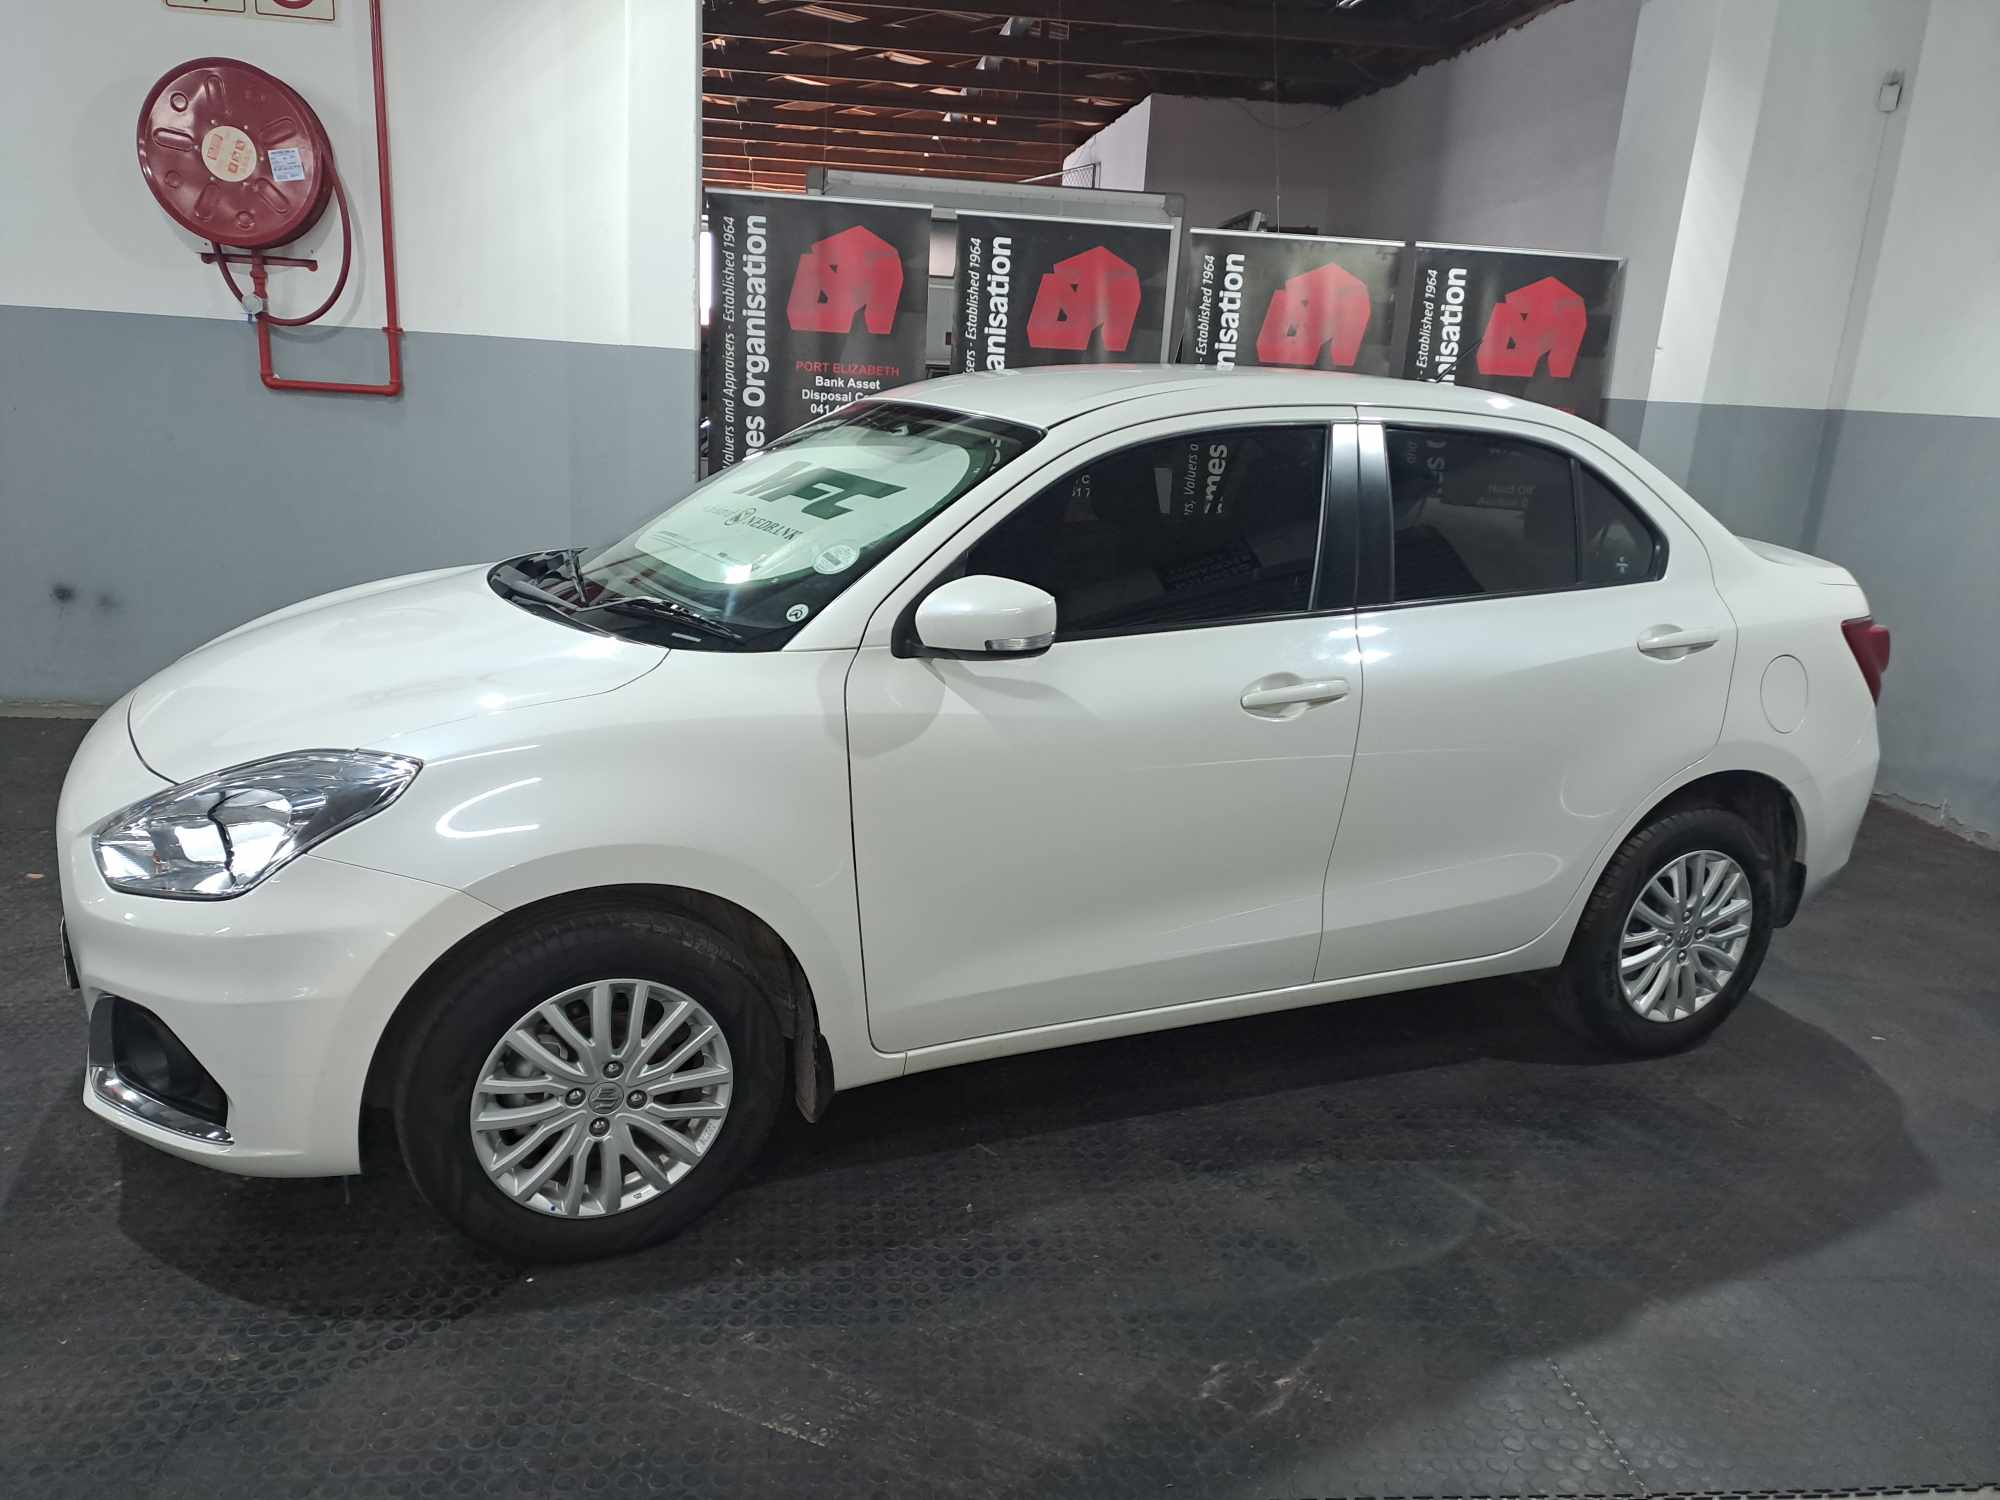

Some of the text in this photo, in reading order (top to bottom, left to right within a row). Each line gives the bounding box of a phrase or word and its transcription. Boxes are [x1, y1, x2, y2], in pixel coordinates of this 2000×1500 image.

[723, 216, 735, 246] 1964
[969, 236, 982, 268] 1964
[1202, 254, 1215, 285] 1964
[722, 247, 735, 321] Established
[742, 215, 769, 405] Organisation
[964, 268, 980, 340] Established
[1195, 286, 1213, 356] Established
[1416, 301, 1434, 368] Established
[1425, 268, 1438, 298] 1964
[723, 332, 735, 397] Appraisers
[795, 360, 900, 376] PORT ELIZABETH
[815, 376, 881, 390] Bank Asset
[723, 399, 735, 422] and
[801, 389, 852, 402] Disposal
[1183, 453, 1199, 495] Valuers
